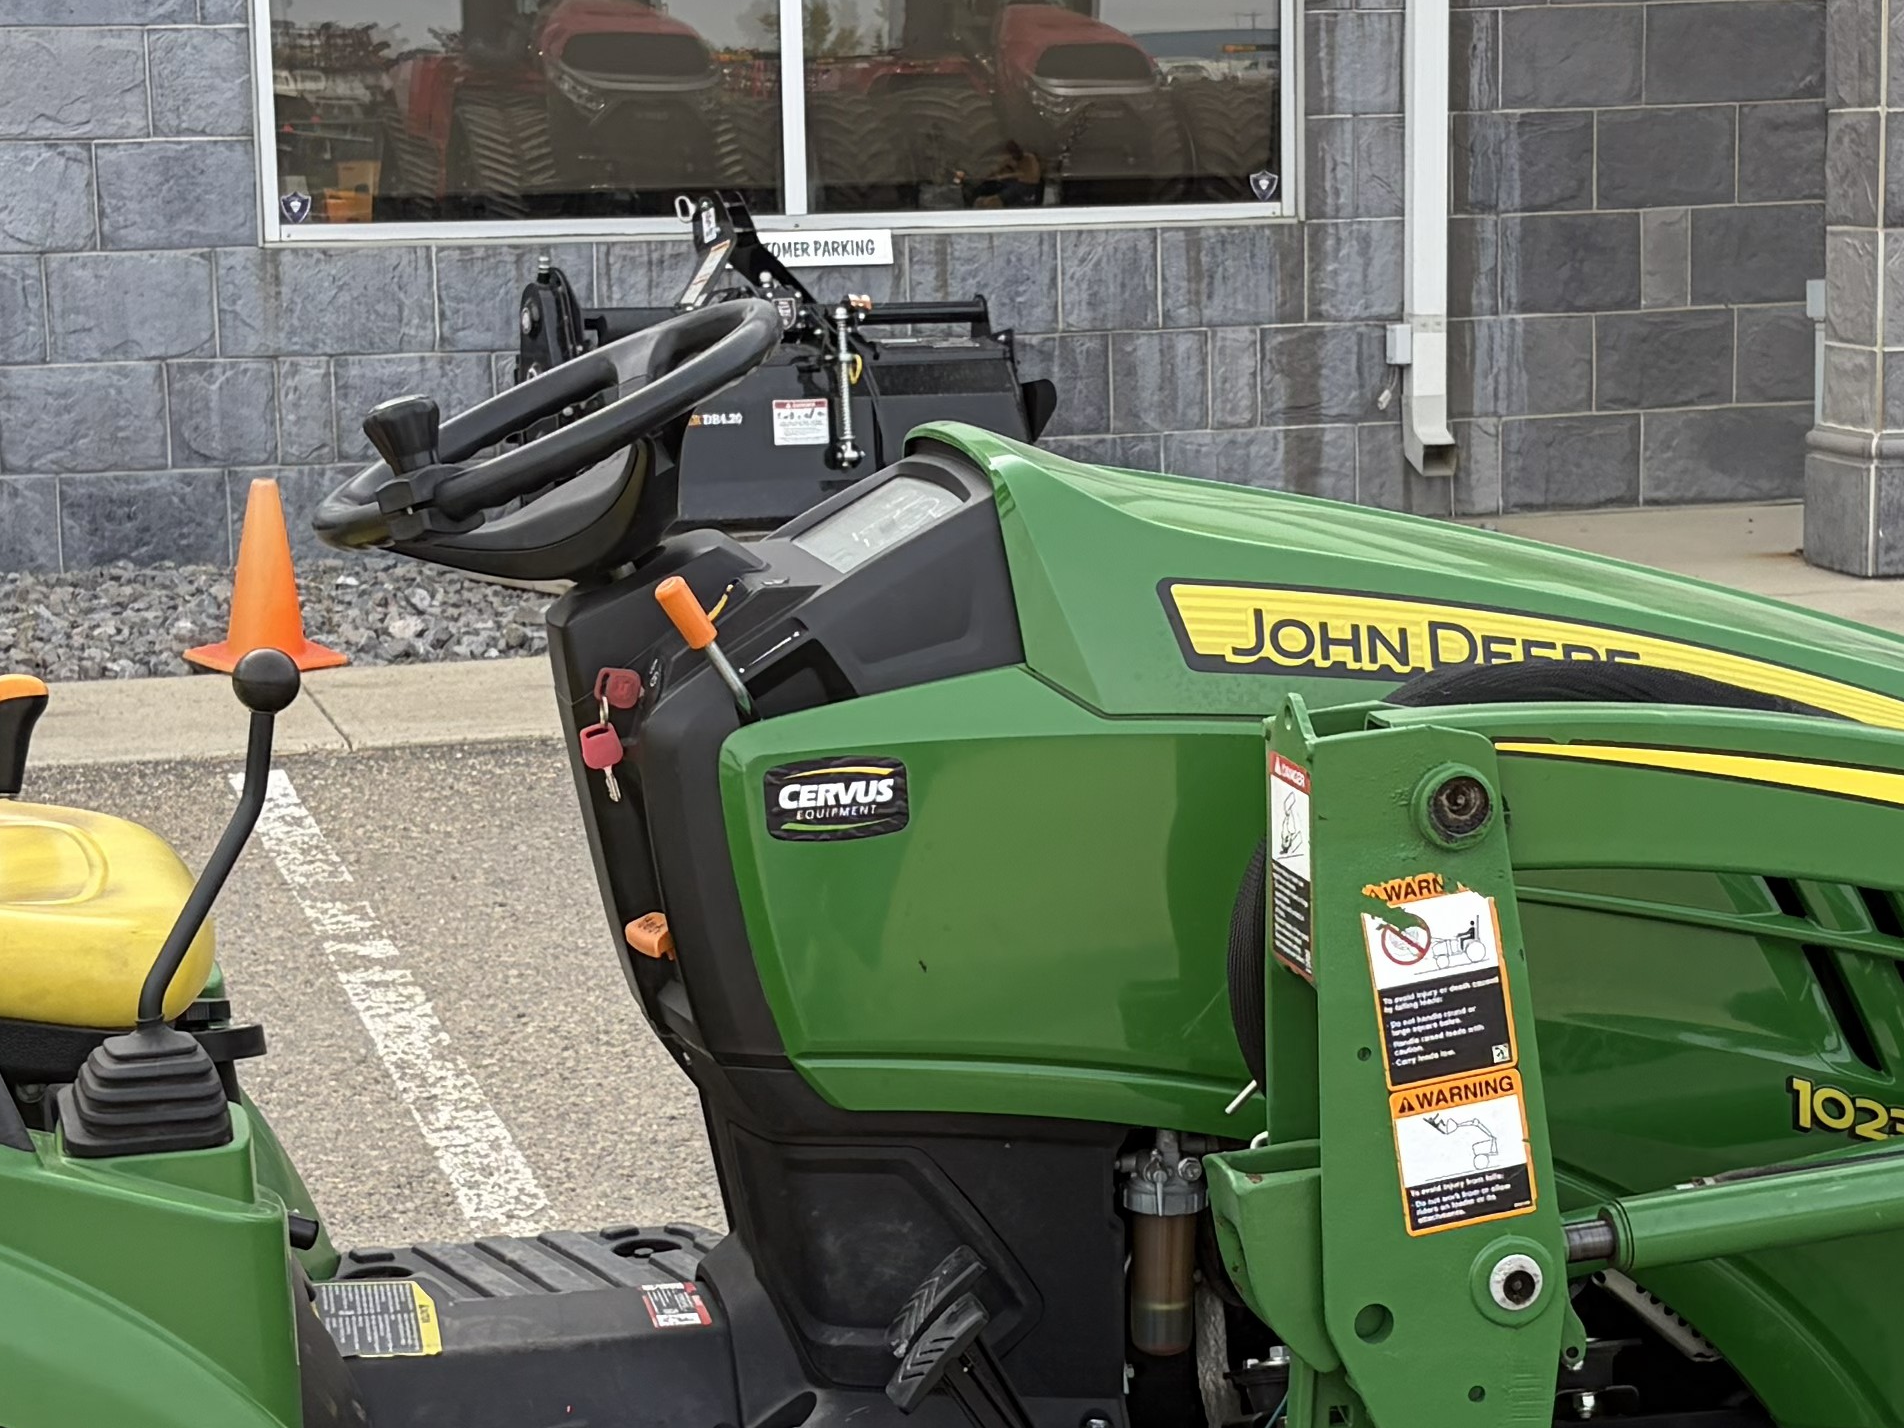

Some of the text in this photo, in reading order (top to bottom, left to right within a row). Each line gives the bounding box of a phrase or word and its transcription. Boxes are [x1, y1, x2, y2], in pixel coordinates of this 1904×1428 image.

[764, 239, 876, 258] TOMER PARKING
[1231, 608, 1641, 669] JOHN DEE
[778, 778, 894, 809] CERVUS
[796, 804, 876, 820] EQUIPMENT
[1383, 877, 1445, 902] WARN
[1415, 1075, 1514, 1109] WARNING
